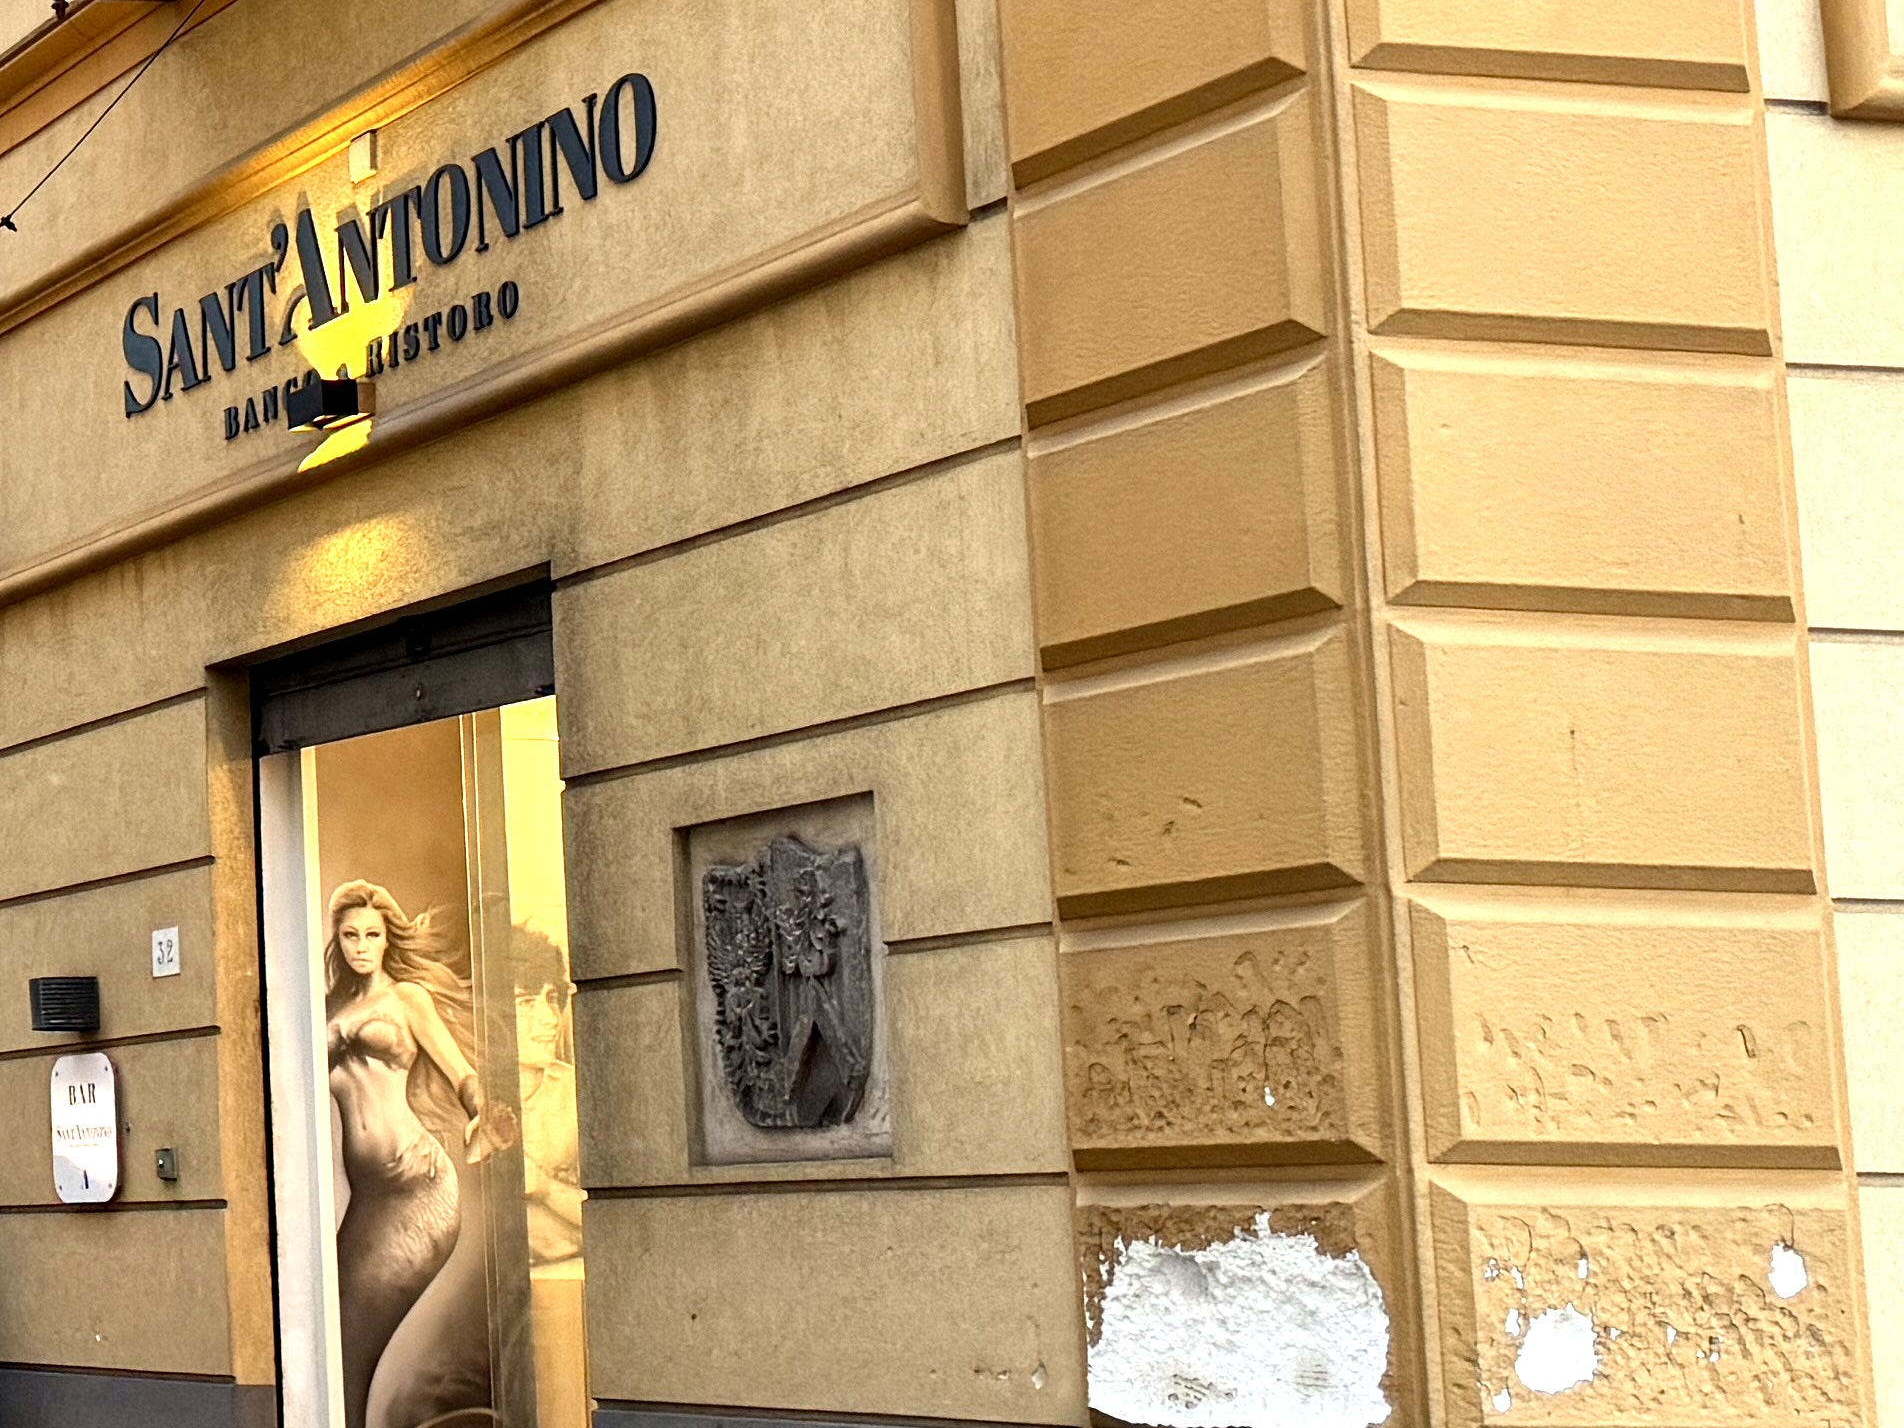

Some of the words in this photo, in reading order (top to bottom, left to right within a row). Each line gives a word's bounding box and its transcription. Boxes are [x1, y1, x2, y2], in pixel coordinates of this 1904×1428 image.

[366, 280, 519, 377] RISTORO
[157, 939, 173, 965] 32
[67, 1083, 97, 1106] BAR
